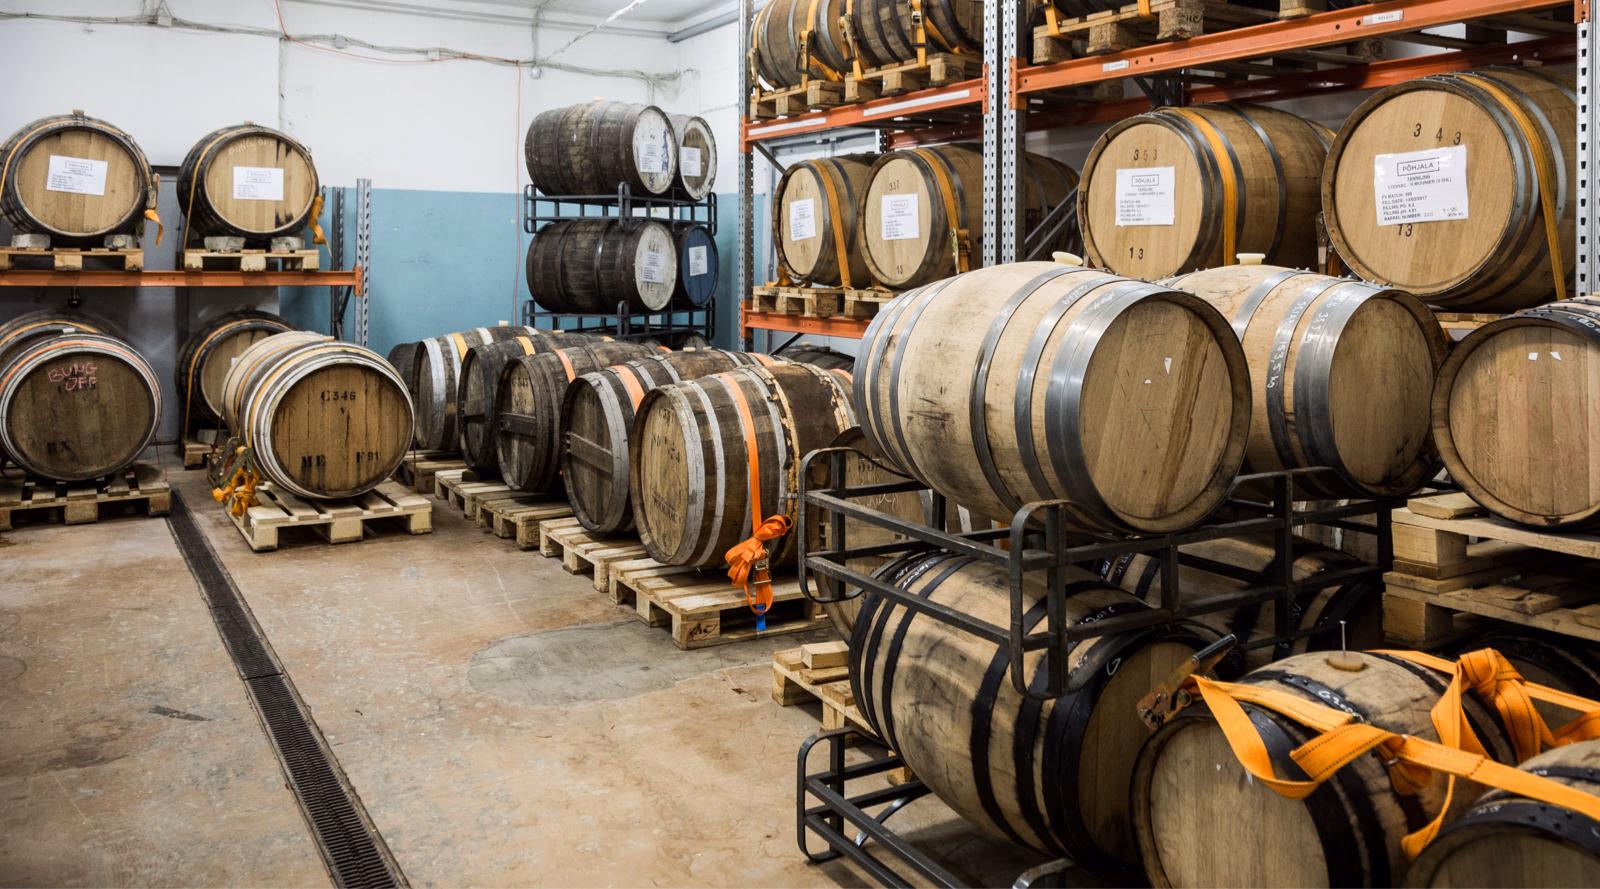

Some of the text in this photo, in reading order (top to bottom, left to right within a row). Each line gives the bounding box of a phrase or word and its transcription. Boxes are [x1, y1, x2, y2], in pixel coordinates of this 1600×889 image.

[1132, 148, 1158, 160] 353
[1402, 162, 1434, 172] PÕHJALA
[1129, 247, 1144, 260] 13
[48, 362, 98, 382] BUNG
[65, 376, 97, 391] OFF
[321, 390, 356, 401] C346
